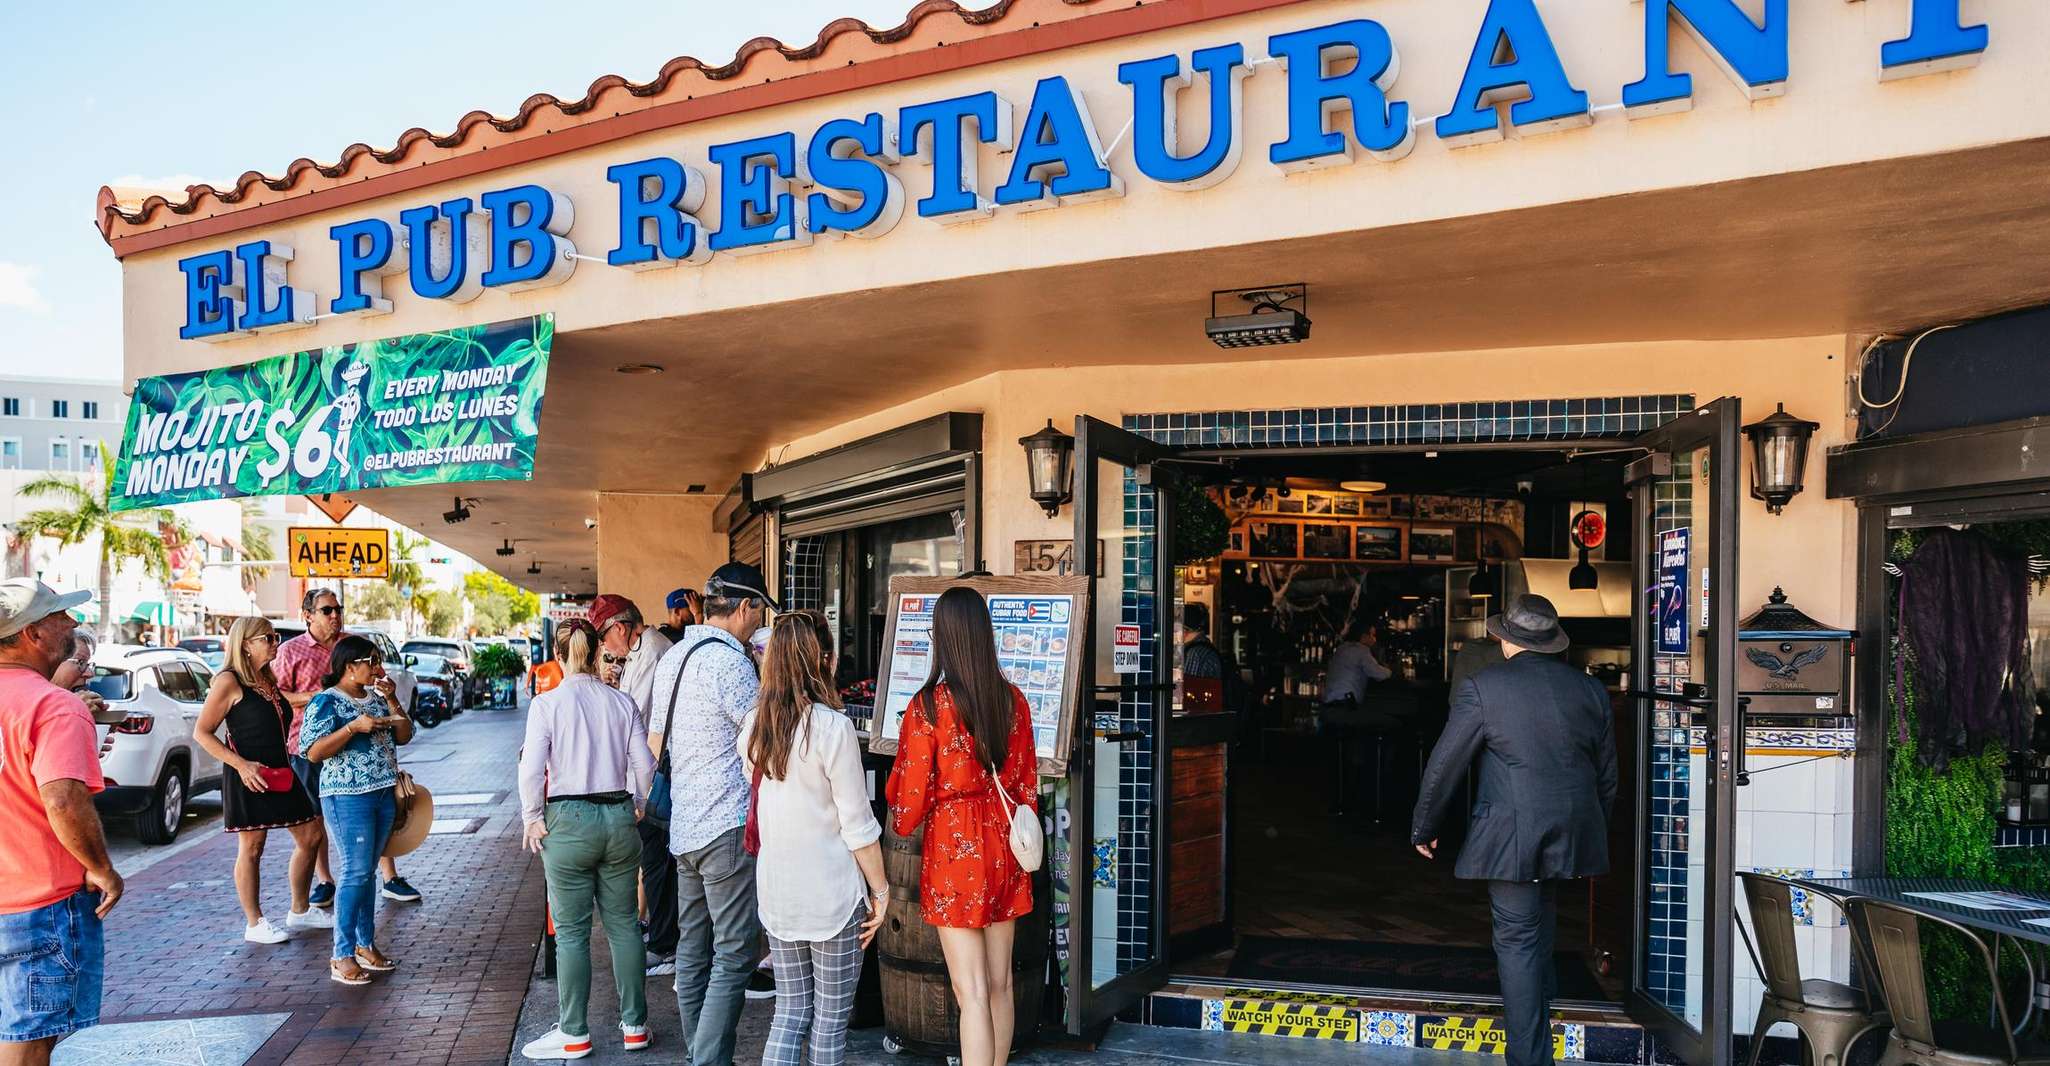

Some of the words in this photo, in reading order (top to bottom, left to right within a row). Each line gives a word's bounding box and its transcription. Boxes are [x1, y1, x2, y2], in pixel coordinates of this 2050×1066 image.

[179, 240, 293, 340] EL
[329, 184, 556, 314] PUB
[384, 375, 439, 400] EVERY
[441, 364, 519, 392] MONDAY
[374, 407, 416, 429] TODO
[420, 402, 454, 424] LOS
[457, 395, 518, 419] LUNES
[133, 400, 264, 456] MOJITO
[256, 399, 336, 488] $6
[124, 447, 249, 497] MONDAY
[363, 442, 516, 471] @ELPUBRESTAURANT
[298, 542, 383, 564] AHEAD
[1022, 543, 1073, 572] 154
[1115, 652, 1125, 665] STEP
[1126, 652, 1138, 666] DOWN
[1227, 1010, 1273, 1023] WATCH
[1277, 1014, 1313, 1026] YOUR
[1318, 1018, 1352, 1029] STEP
[1427, 1026, 1475, 1040] WATCH
[1480, 1031, 1506, 1042] YOU
